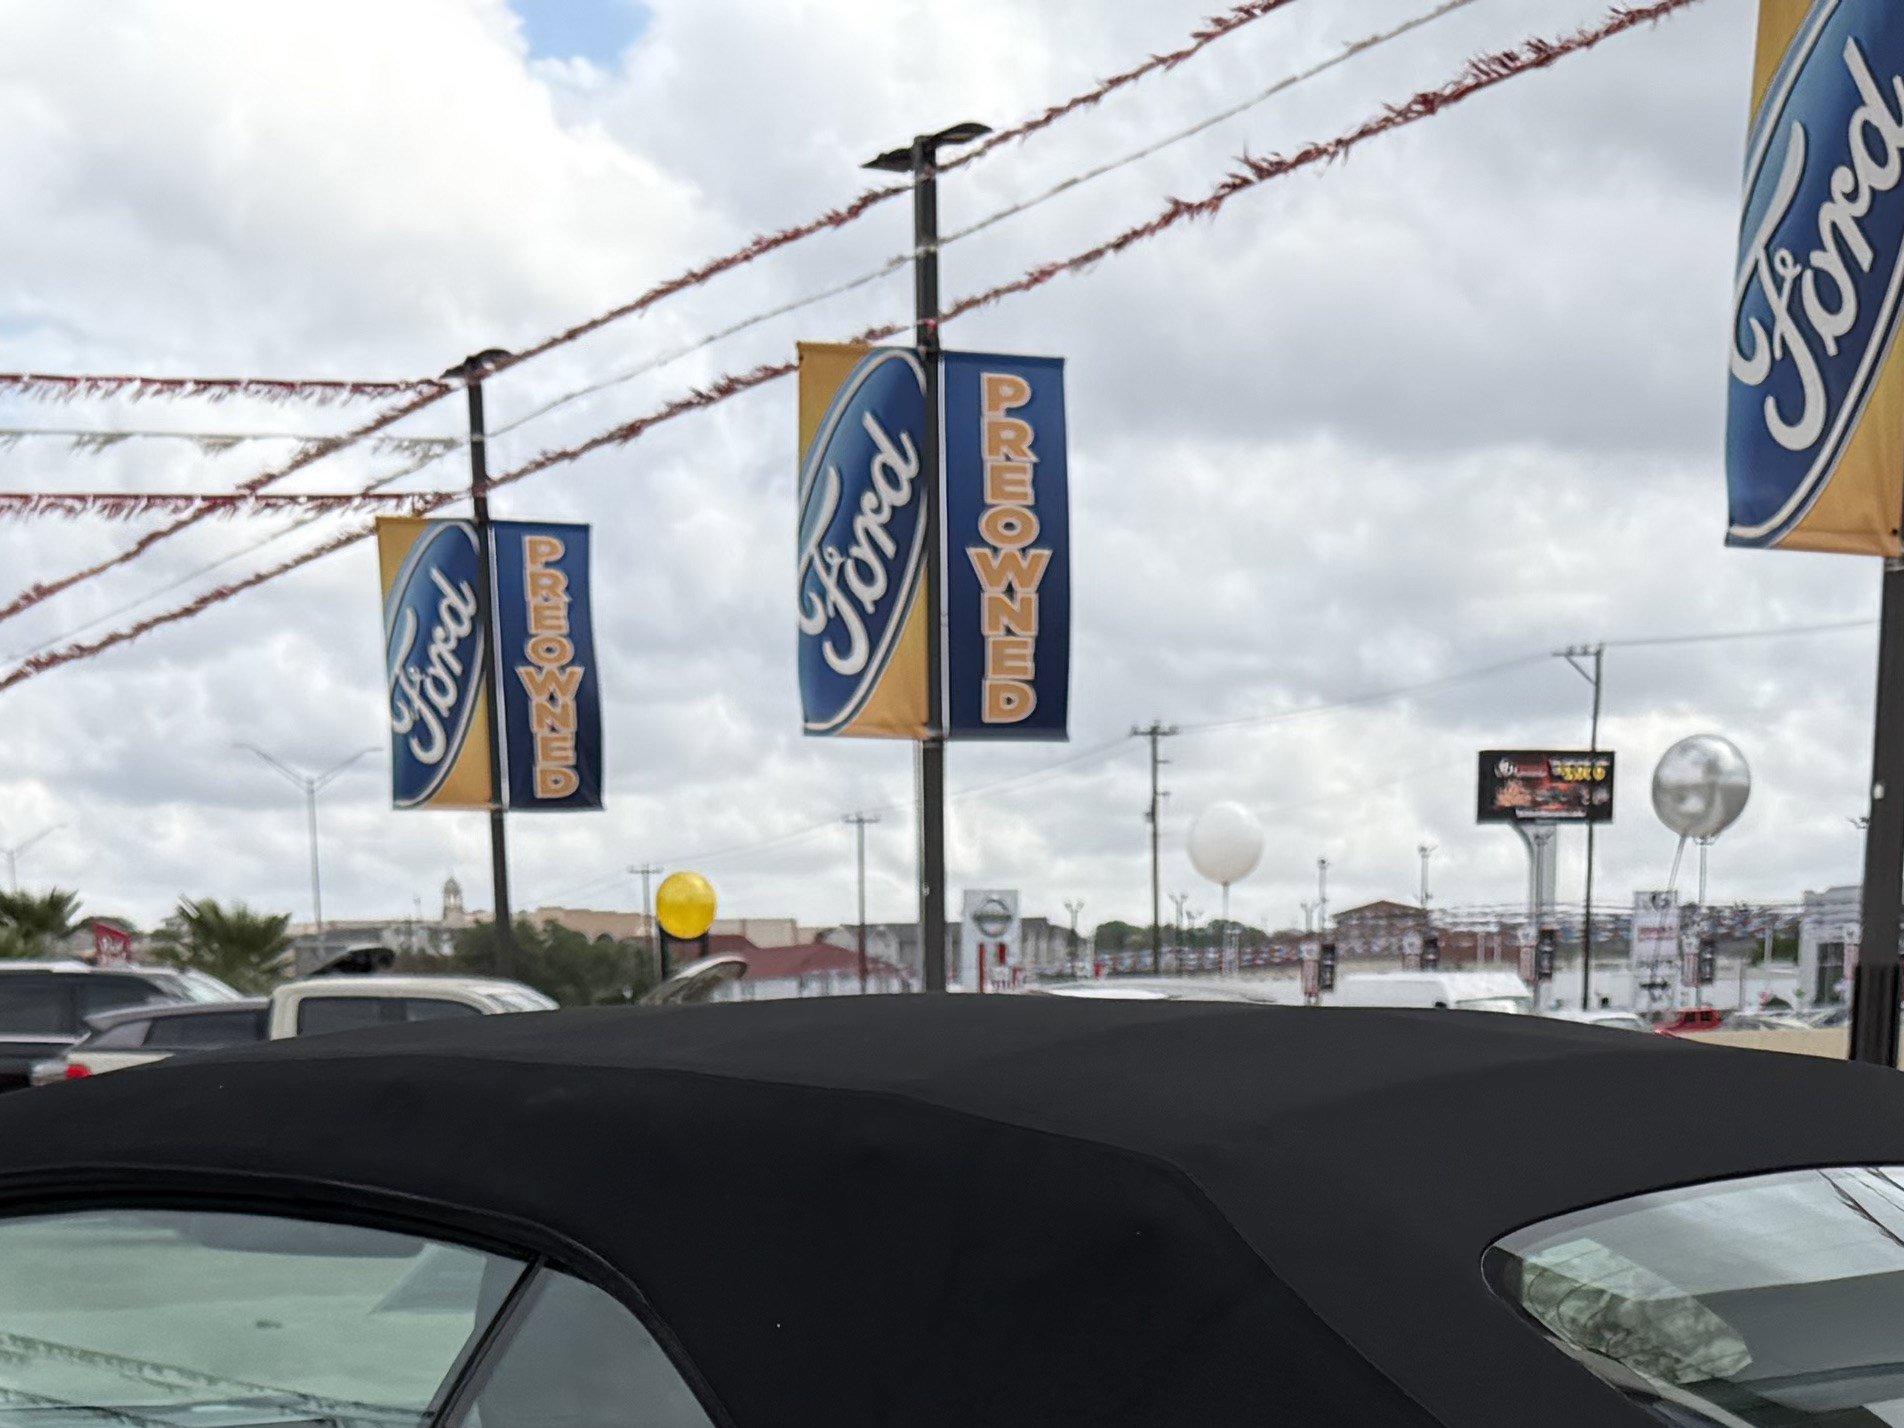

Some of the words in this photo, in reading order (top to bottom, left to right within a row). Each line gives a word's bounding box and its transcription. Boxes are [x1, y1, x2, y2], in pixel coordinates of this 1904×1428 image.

[392, 567, 478, 765] Ford
[515, 535, 585, 800] PREOWNED
[798, 410, 920, 676] Ford
[966, 372, 1053, 724] PREOWNED
